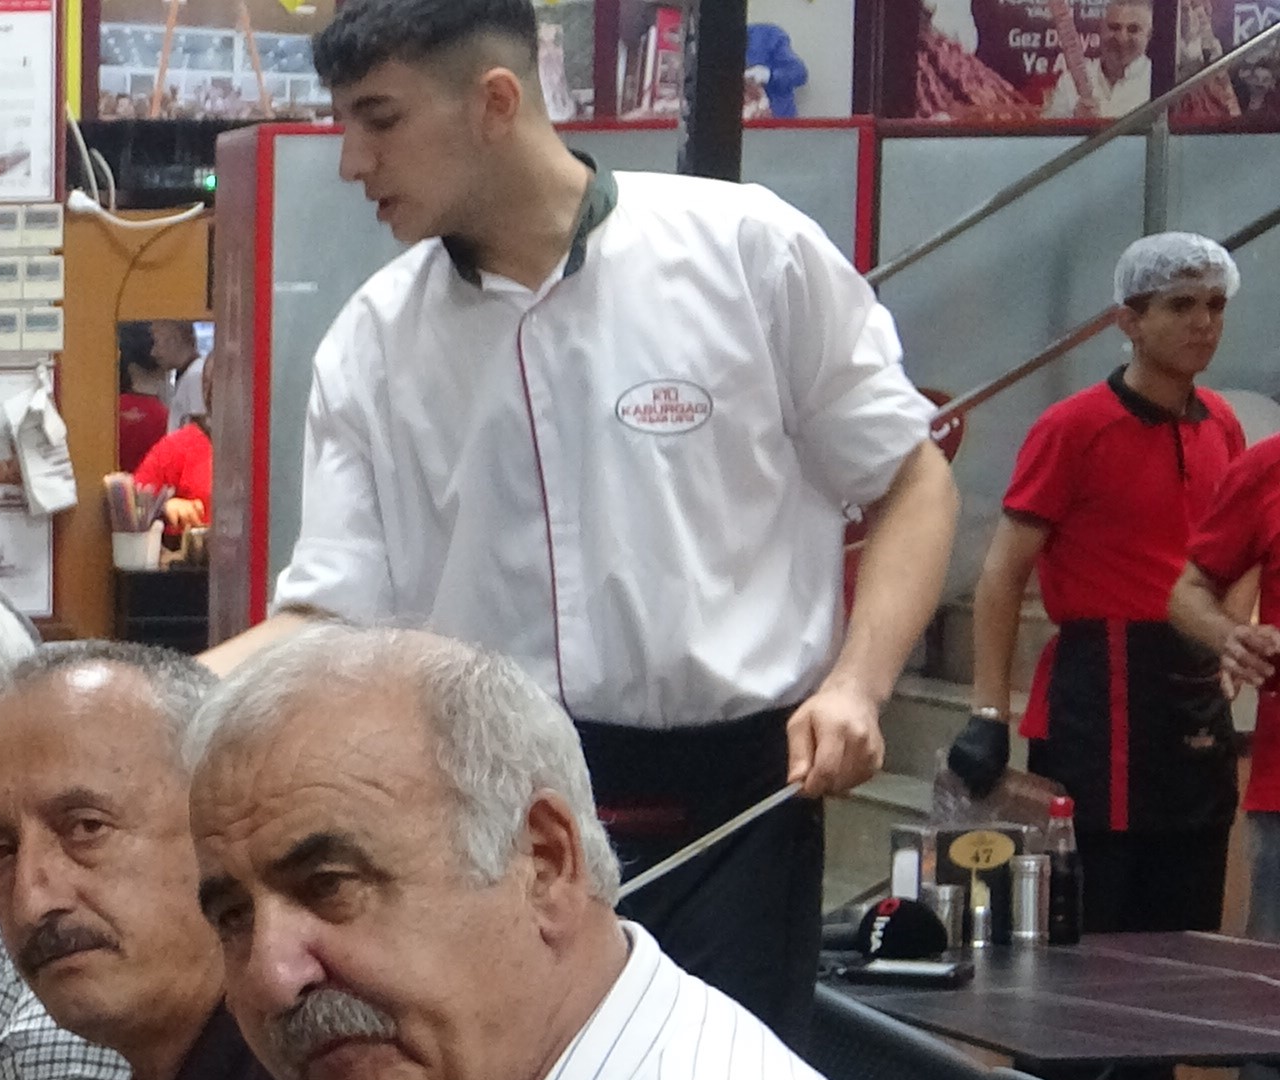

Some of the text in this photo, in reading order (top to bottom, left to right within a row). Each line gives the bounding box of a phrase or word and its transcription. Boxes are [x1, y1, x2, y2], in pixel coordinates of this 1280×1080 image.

[1008, 28, 1100, 52] Gez Dya
[971, 849, 993, 864] 47
